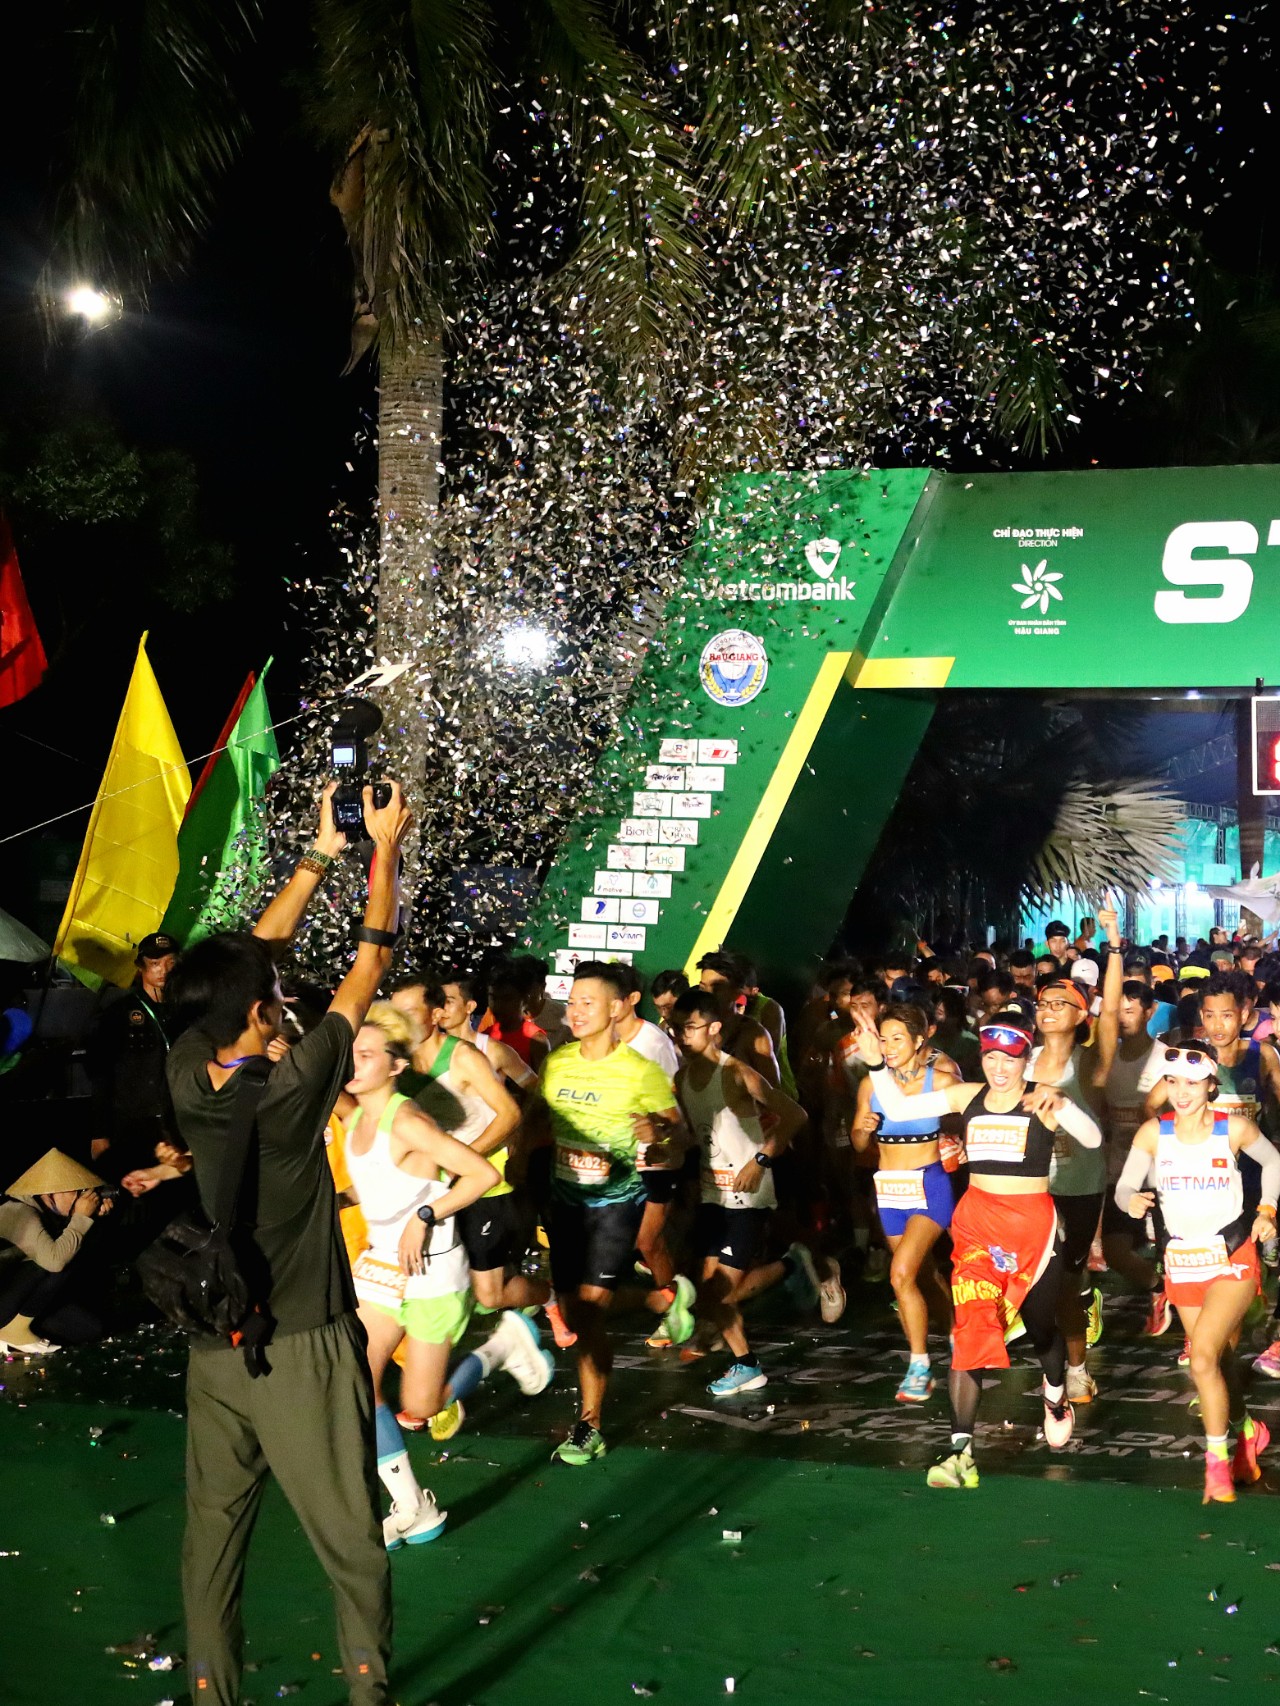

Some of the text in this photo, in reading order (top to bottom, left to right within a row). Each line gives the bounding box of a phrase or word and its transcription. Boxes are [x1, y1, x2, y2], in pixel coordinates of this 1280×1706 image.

[1012, 528, 1034, 540] ĐẠO
[1018, 539, 1058, 548] DIRECTION
[1033, 626, 1060, 635] GIANG
[556, 1088, 602, 1102] RUN
[1158, 1176, 1230, 1191] VIETNAM
